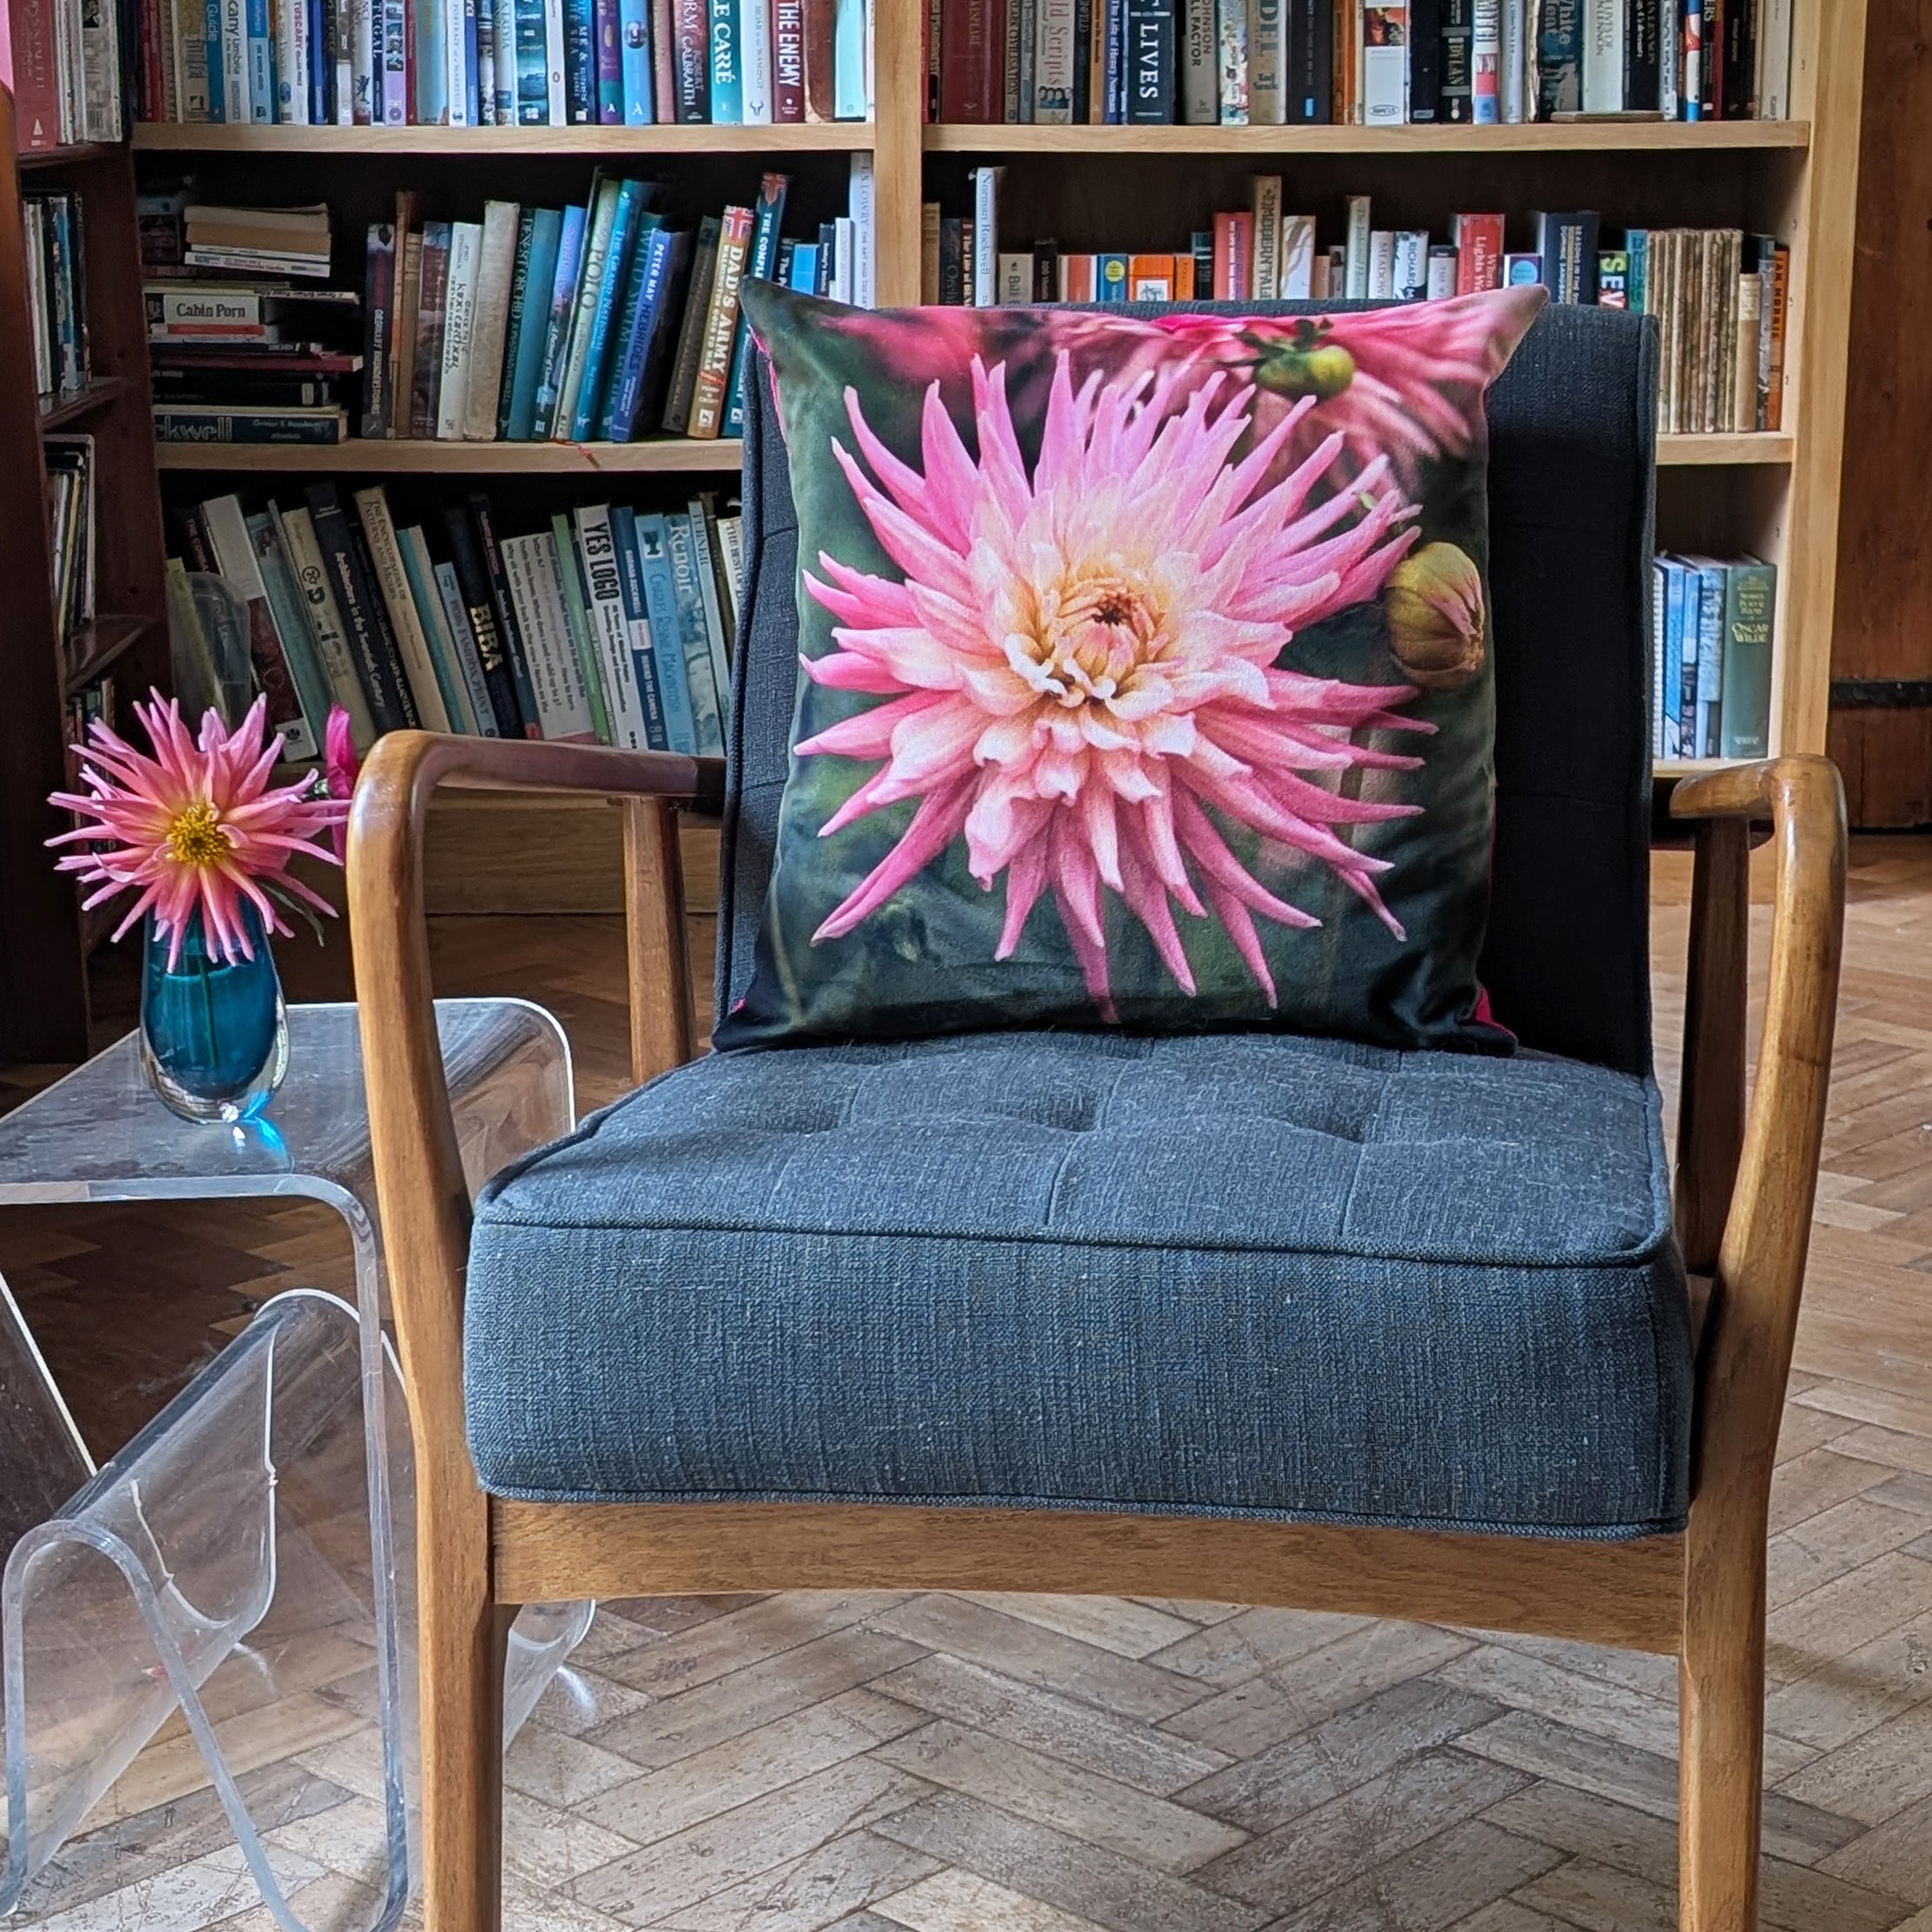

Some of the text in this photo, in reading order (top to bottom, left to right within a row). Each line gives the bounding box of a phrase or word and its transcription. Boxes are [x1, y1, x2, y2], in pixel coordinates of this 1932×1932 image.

[207, 3, 219, 42] Guide
[294, 2, 304, 49] TUSCANY
[777, 3, 801, 87] THE ENEMY
[1190, 16, 1202, 68] FACTOR
[680, 36, 696, 106] GALBRAITH
[693, 49, 705, 90] ROBERT
[713, 23, 737, 84] CARRÉ
[1006, 30, 1019, 95] CIVILISATION
[1043, 26, 1070, 86] Scripts
[1139, 23, 1160, 99] LIVES
[1448, 43, 1465, 85] DYLAN
[760, 212, 772, 233] THE
[963, 235, 973, 253] The
[979, 173, 993, 276] Norman Rockwell
[579, 247, 606, 311] POLO
[631, 228, 652, 281] WILD
[1406, 241, 1418, 286] RICHARD
[1473, 236, 1488, 273] Lights
[176, 302, 246, 318] Cabin Porn
[628, 242, 664, 371] PETER MAY HEBRIDES
[712, 246, 744, 373] DAD'S ARMY
[1600, 257, 1628, 308] SEV
[1771, 257, 1784, 339] JAN MORRIS
[618, 289, 639, 344] SWIM
[582, 521, 620, 601] YES LOGO
[669, 524, 693, 595] Renoir
[691, 508, 709, 567] TURNER
[726, 526, 738, 547] THE
[730, 547, 742, 571] BEST
[649, 572, 669, 613] CHARLES
[470, 602, 504, 671] BIBA
